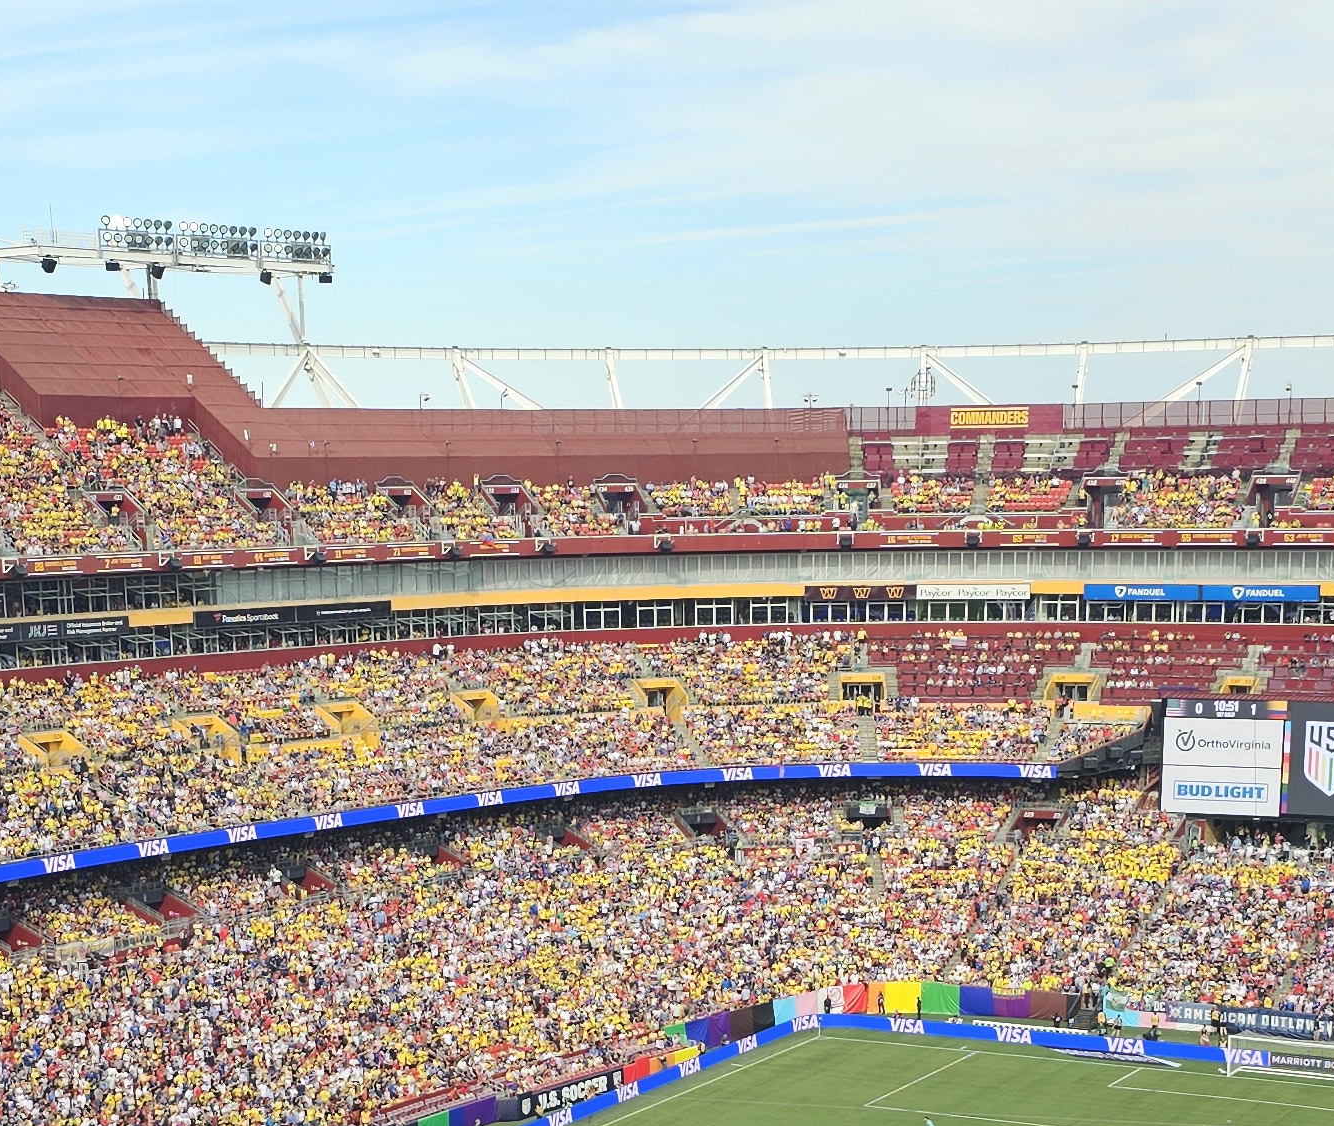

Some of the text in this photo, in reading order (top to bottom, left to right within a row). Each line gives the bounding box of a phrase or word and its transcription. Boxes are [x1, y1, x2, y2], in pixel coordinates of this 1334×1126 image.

[950, 411, 1029, 425] COMMANDERS
[920, 587, 1028, 598] Paycor Paycor Paycor
[1127, 587, 1165, 597] FANDUEL
[1245, 588, 1284, 598] FANDUEL
[1195, 700, 1256, 716] 0 10:51 1
[1198, 739, 1271, 750] OrthoVirginia
[722, 766, 753, 781] VISA
[817, 763, 851, 778] VISA
[916, 762, 952, 777] VISA
[1018, 764, 1053, 779] VISA
[632, 772, 662, 788] VISA
[552, 781, 581, 797] VISA
[1177, 784, 1265, 799] BUD LIGHT
[476, 790, 504, 807] VISA
[395, 801, 425, 818] VISA
[312, 812, 343, 830] VISA
[225, 823, 257, 843] VISA
[135, 837, 170, 857] VISA
[41, 853, 76, 873] VISA
[792, 1015, 817, 1032] VISA
[890, 1017, 925, 1034] VISA
[737, 1034, 758, 1054] VISA
[996, 1027, 1032, 1044] VISA
[1105, 1037, 1144, 1054] VISA
[1223, 1048, 1264, 1066] VISA
[1271, 1055, 1322, 1070] MARRIOTT
[680, 1056, 702, 1079] VISA
[537, 1090, 561, 1112] U.S.
[615, 1081, 639, 1104] VISA
